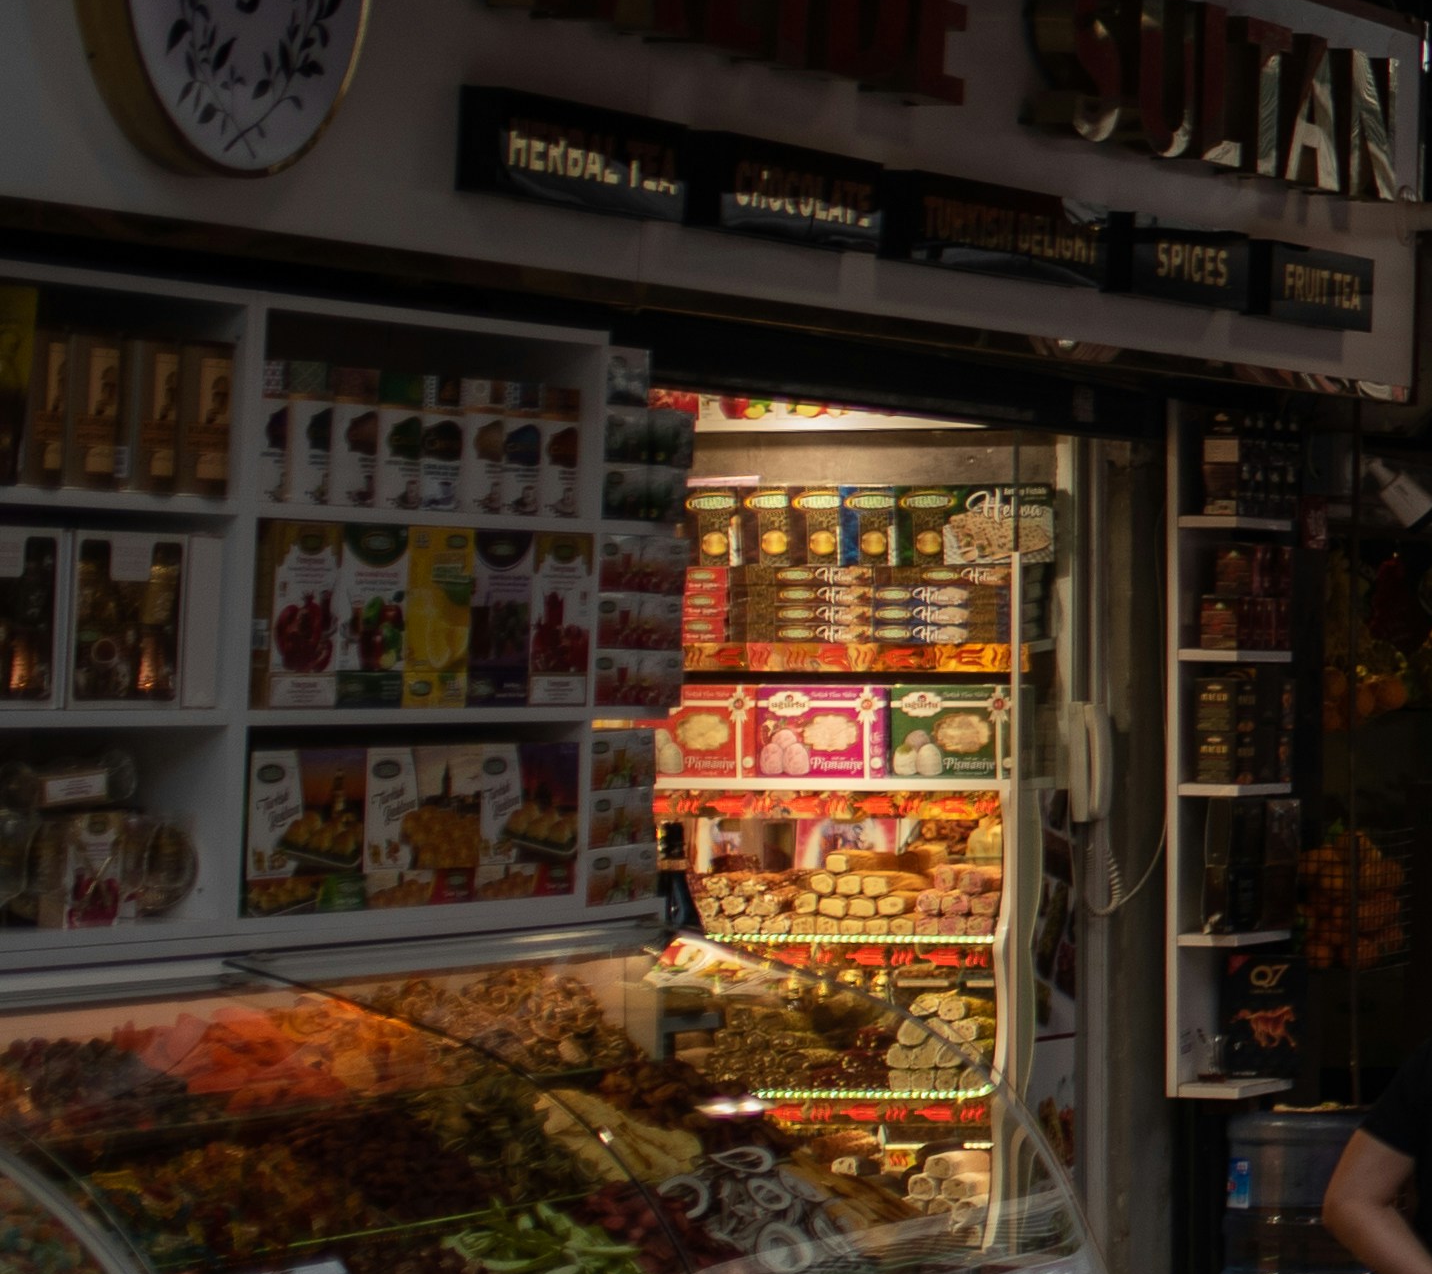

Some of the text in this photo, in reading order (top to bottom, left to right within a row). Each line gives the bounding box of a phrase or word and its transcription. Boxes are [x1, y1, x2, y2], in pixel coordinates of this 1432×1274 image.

[507, 116, 679, 195] HERBAL TEA
[736, 160, 873, 227] CHOCOLATE
[1155, 239, 1228, 286] SPICES
[1285, 263, 1362, 311] FRUIT TEA
[1250, 964, 1290, 989] Q7
